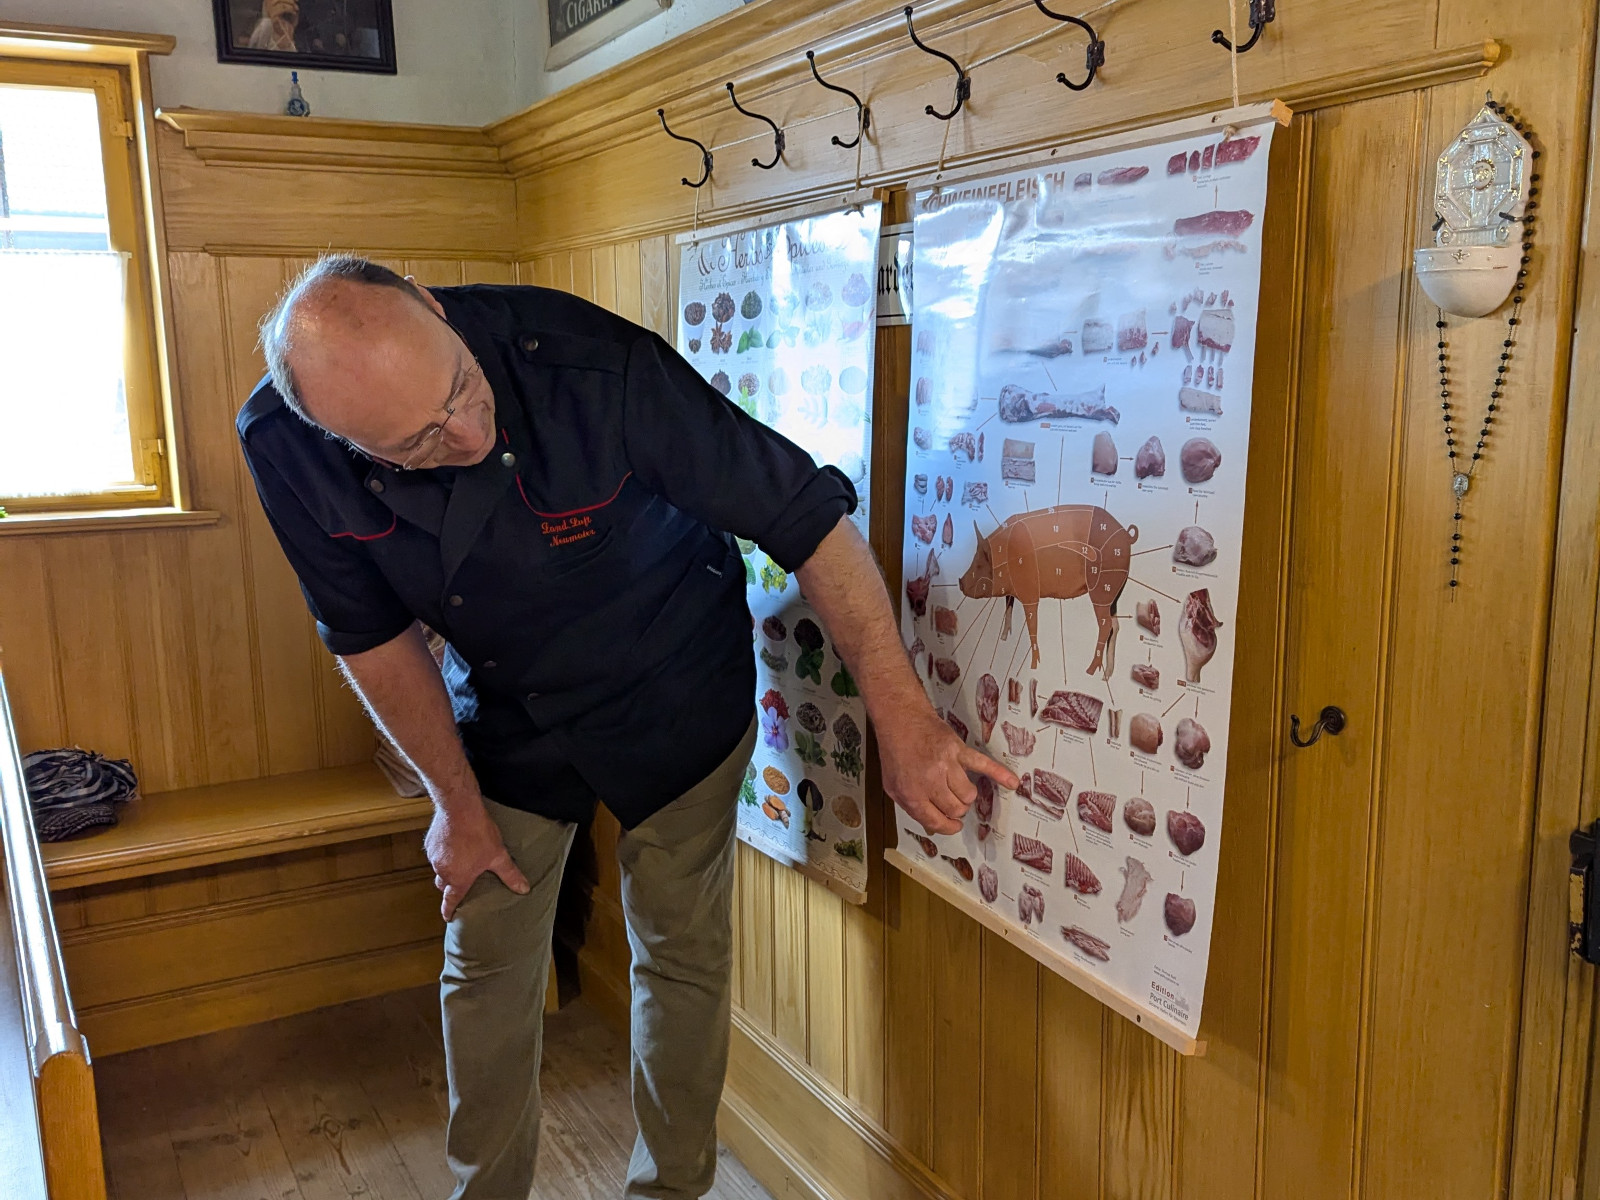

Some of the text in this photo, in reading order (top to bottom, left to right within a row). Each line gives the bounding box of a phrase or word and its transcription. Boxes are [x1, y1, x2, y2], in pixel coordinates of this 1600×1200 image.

[566, 0, 617, 28] CIGAR
[1099, 523, 1108, 531] 14
[1081, 546, 1088, 554] 12
[1113, 548, 1121, 557] 15
[1055, 568, 1062, 576] 11
[1091, 566, 1098, 574] 13
[1104, 583, 1111, 592] 16
[1151, 981, 1175, 1000] Edition
[1150, 992, 1163, 1006] Port
[1162, 1000, 1189, 1021] Culinaire
